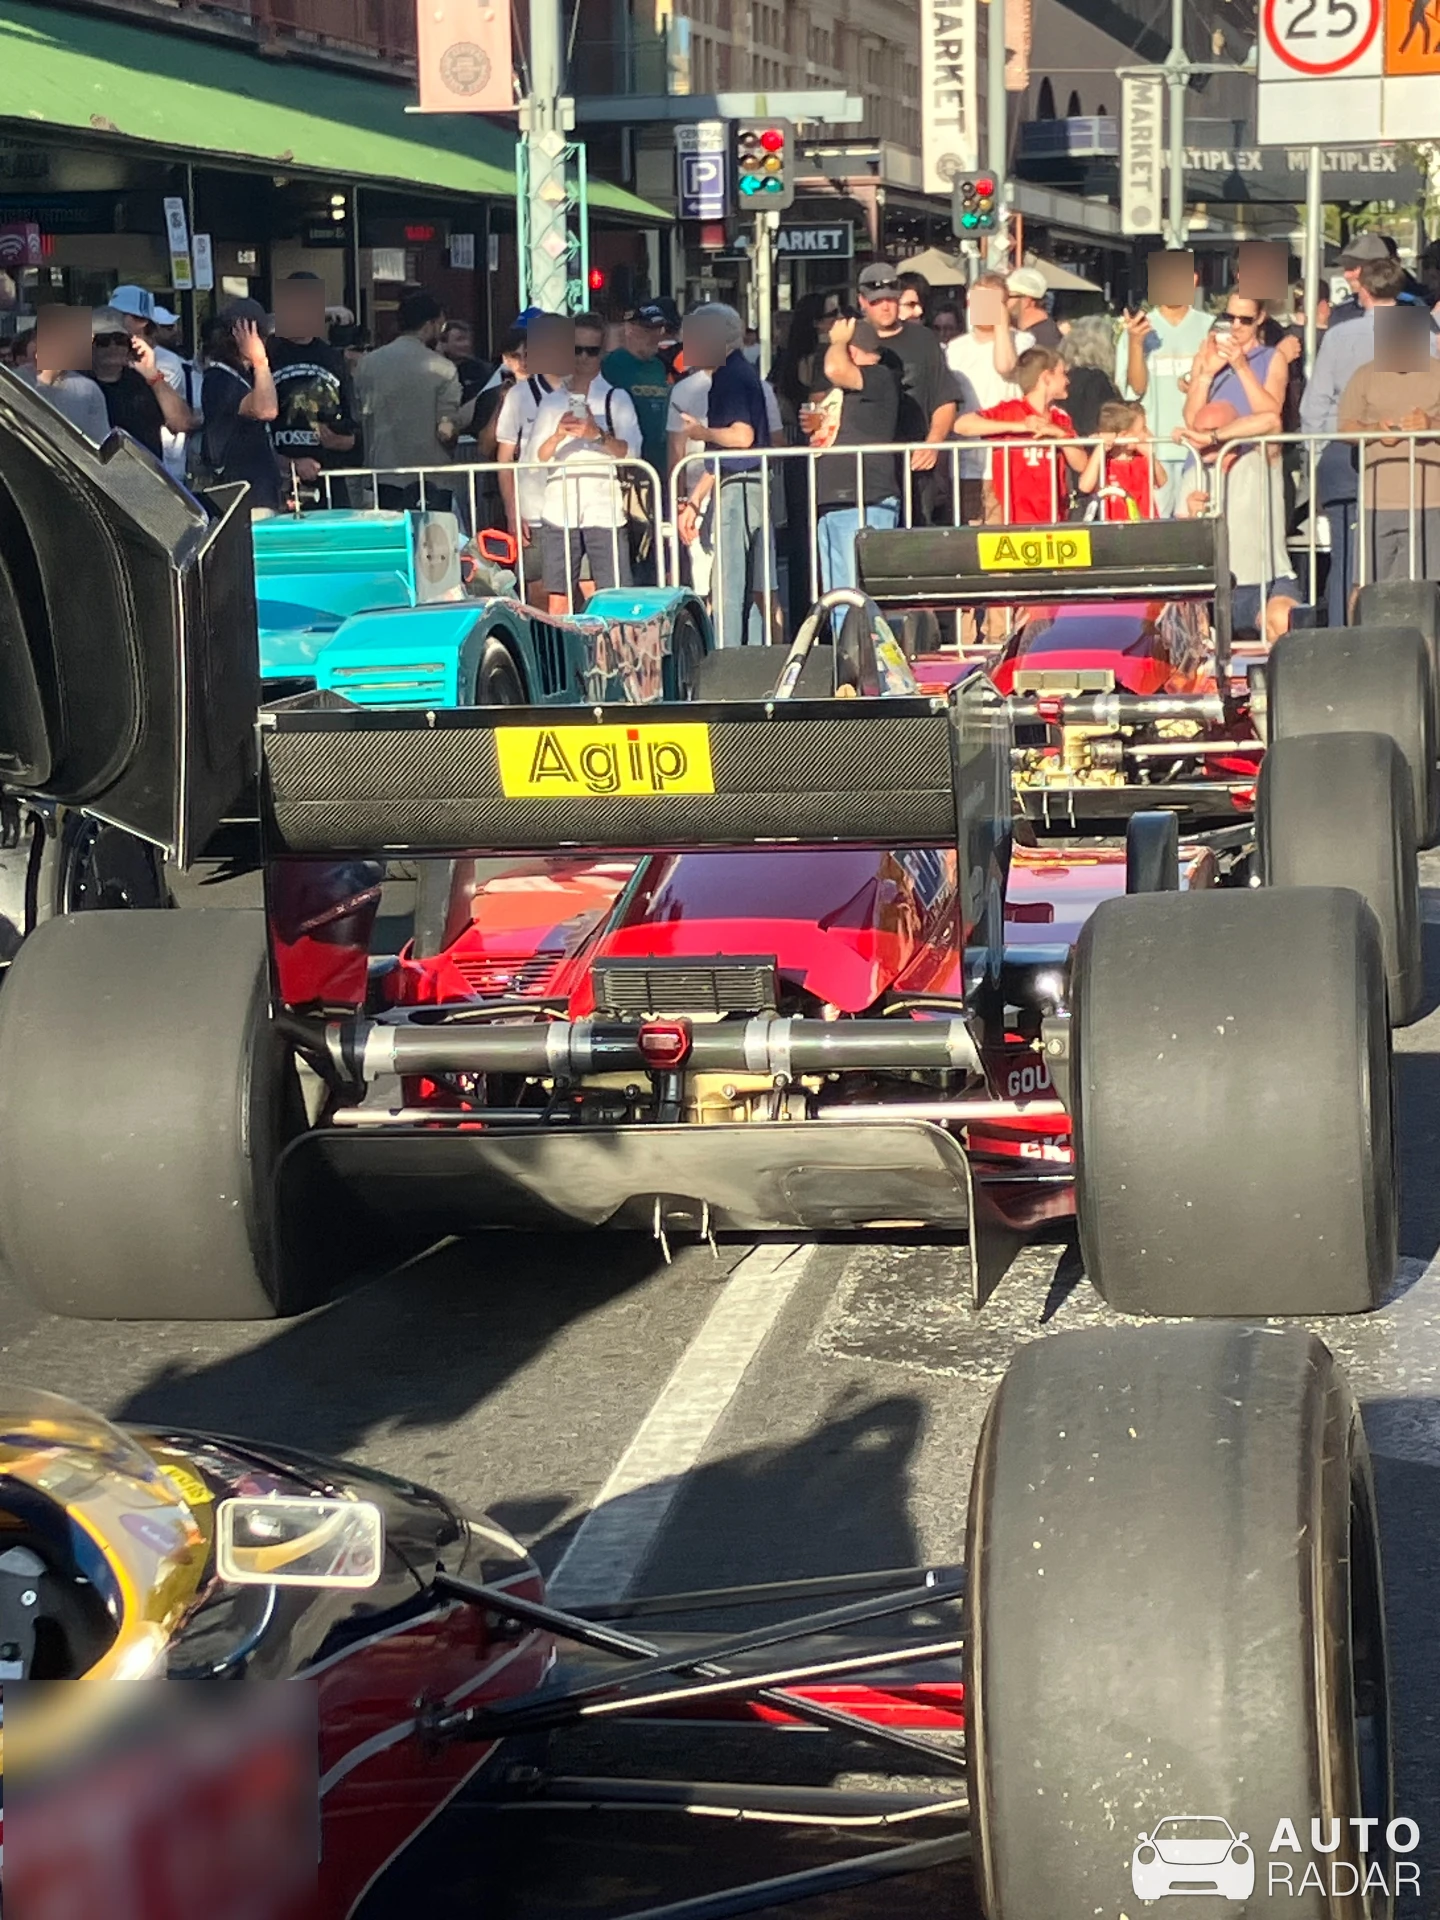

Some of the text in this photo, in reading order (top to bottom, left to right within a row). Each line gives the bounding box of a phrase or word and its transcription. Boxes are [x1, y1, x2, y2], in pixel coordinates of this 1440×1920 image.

[1285, 0, 1358, 40] 25
[1130, 84, 1153, 194] MARKET
[691, 162, 717, 193] P
[1160, 151, 1263, 172] LTIPLEX
[1287, 151, 1397, 173] MLTIPLEX
[777, 229, 844, 251] ARKET
[993, 534, 1077, 567] Agip
[528, 728, 688, 794] Agip
[1008, 1064, 1051, 1097] GOU
